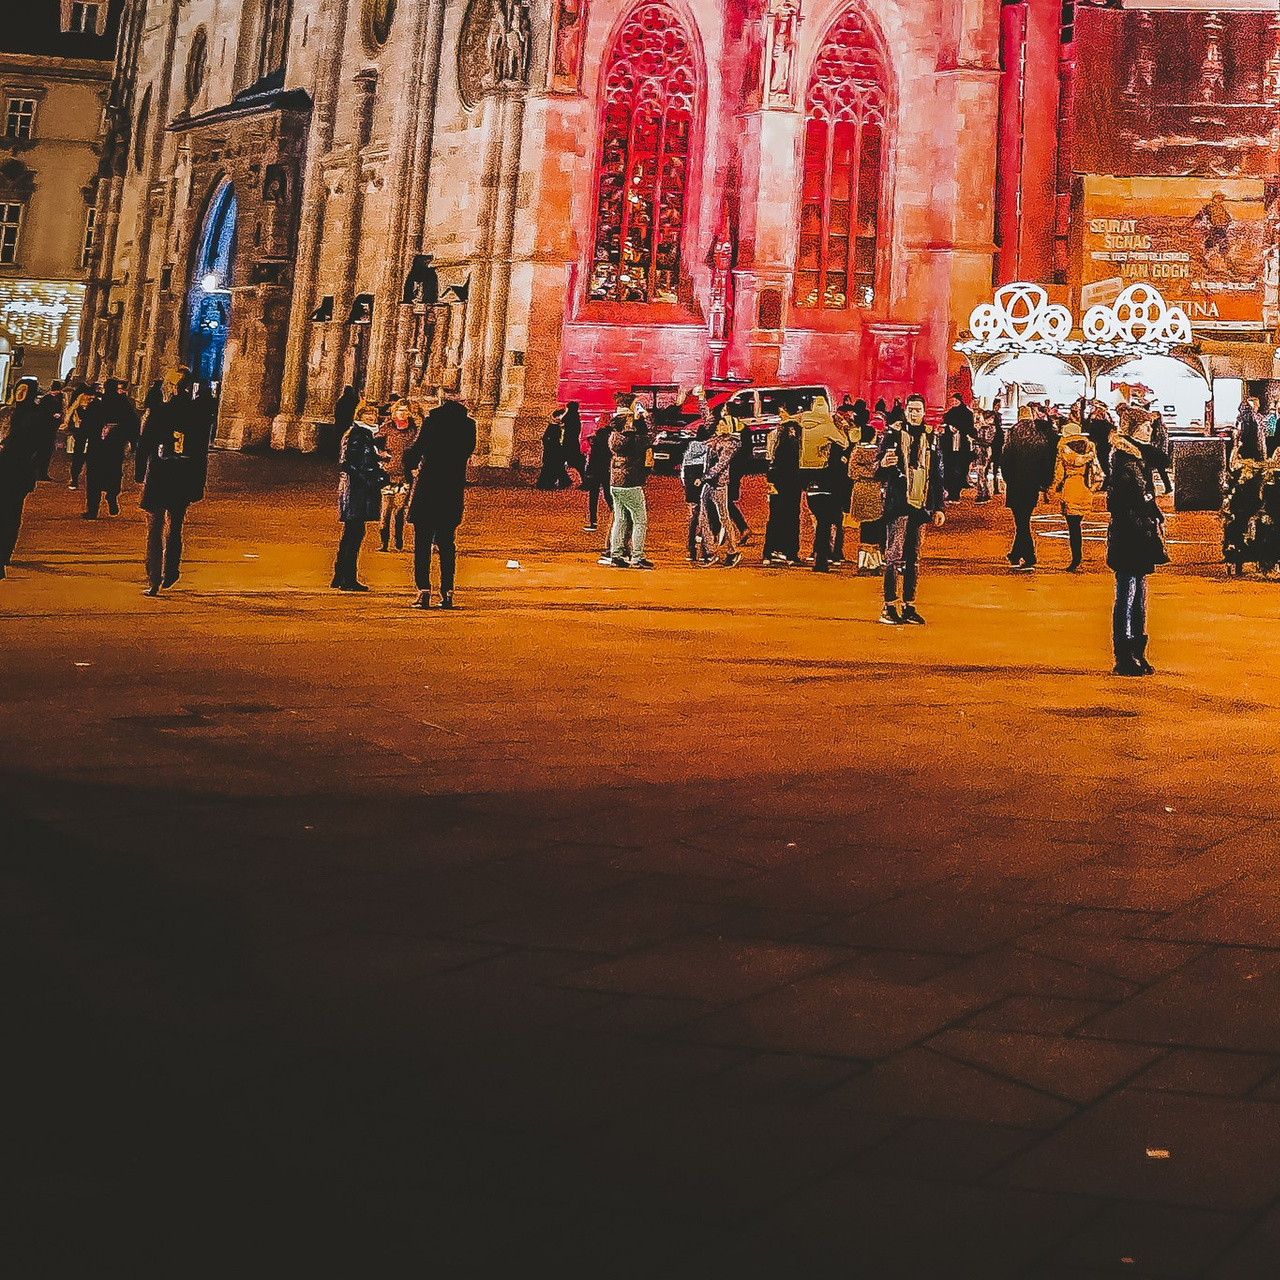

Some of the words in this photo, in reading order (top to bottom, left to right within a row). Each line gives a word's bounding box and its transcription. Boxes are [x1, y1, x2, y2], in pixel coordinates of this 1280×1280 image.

[1090, 218, 1138, 233] SEURAT
[1104, 235, 1151, 249] SIGNAC
[1120, 263, 1149, 278] VAN
[1152, 263, 1190, 278] GOGH
